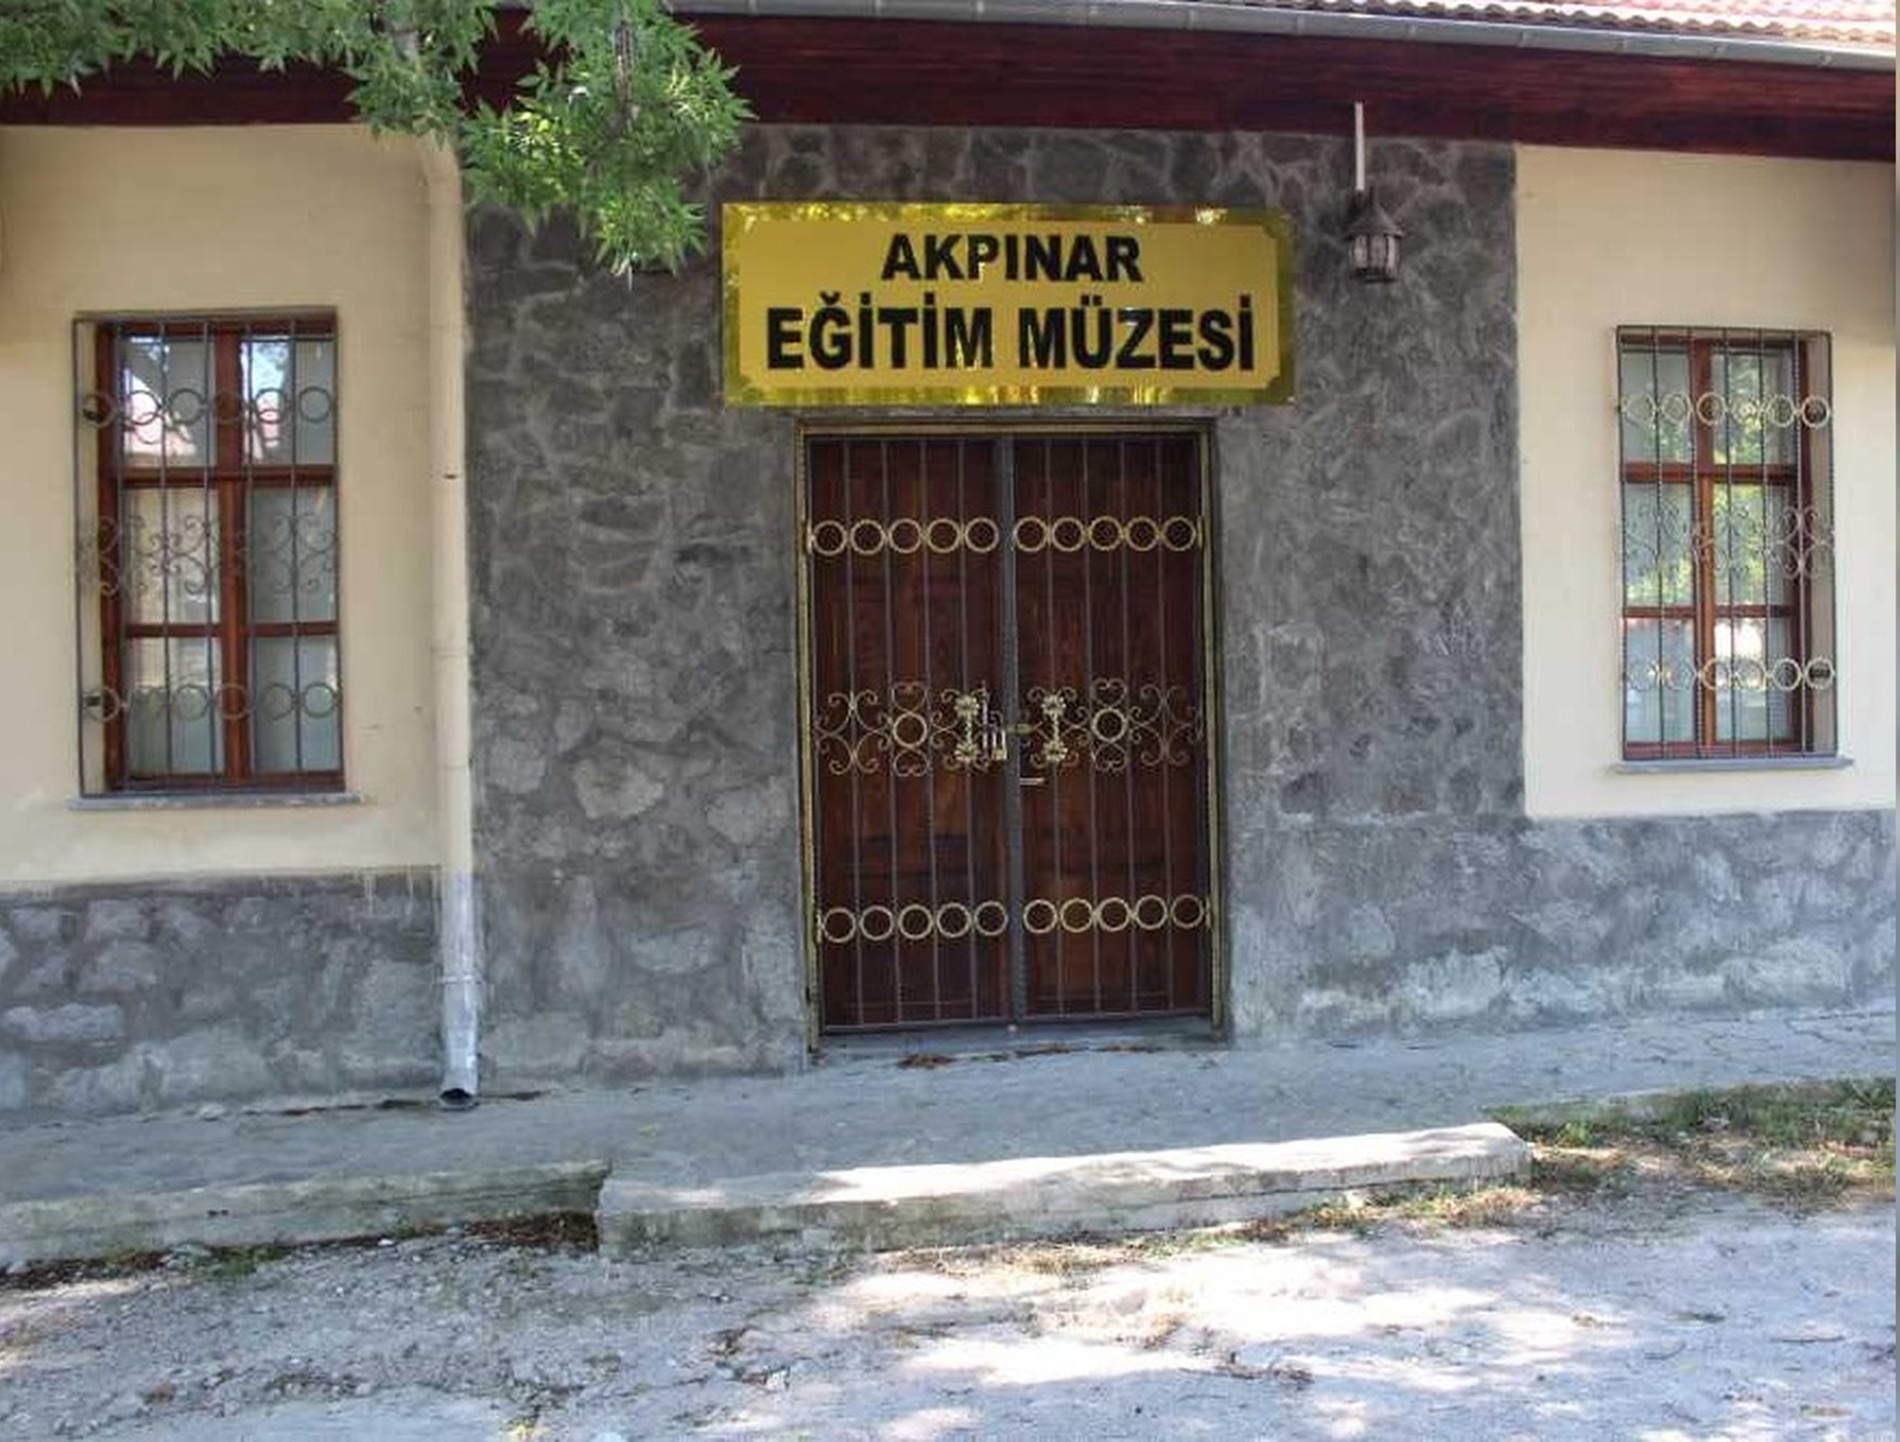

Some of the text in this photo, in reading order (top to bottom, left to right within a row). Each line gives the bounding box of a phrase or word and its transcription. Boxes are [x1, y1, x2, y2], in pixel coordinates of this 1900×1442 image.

[881, 233, 1143, 283] AKPINAR
[767, 291, 1254, 372] EĞİTİM MÜZESİ
